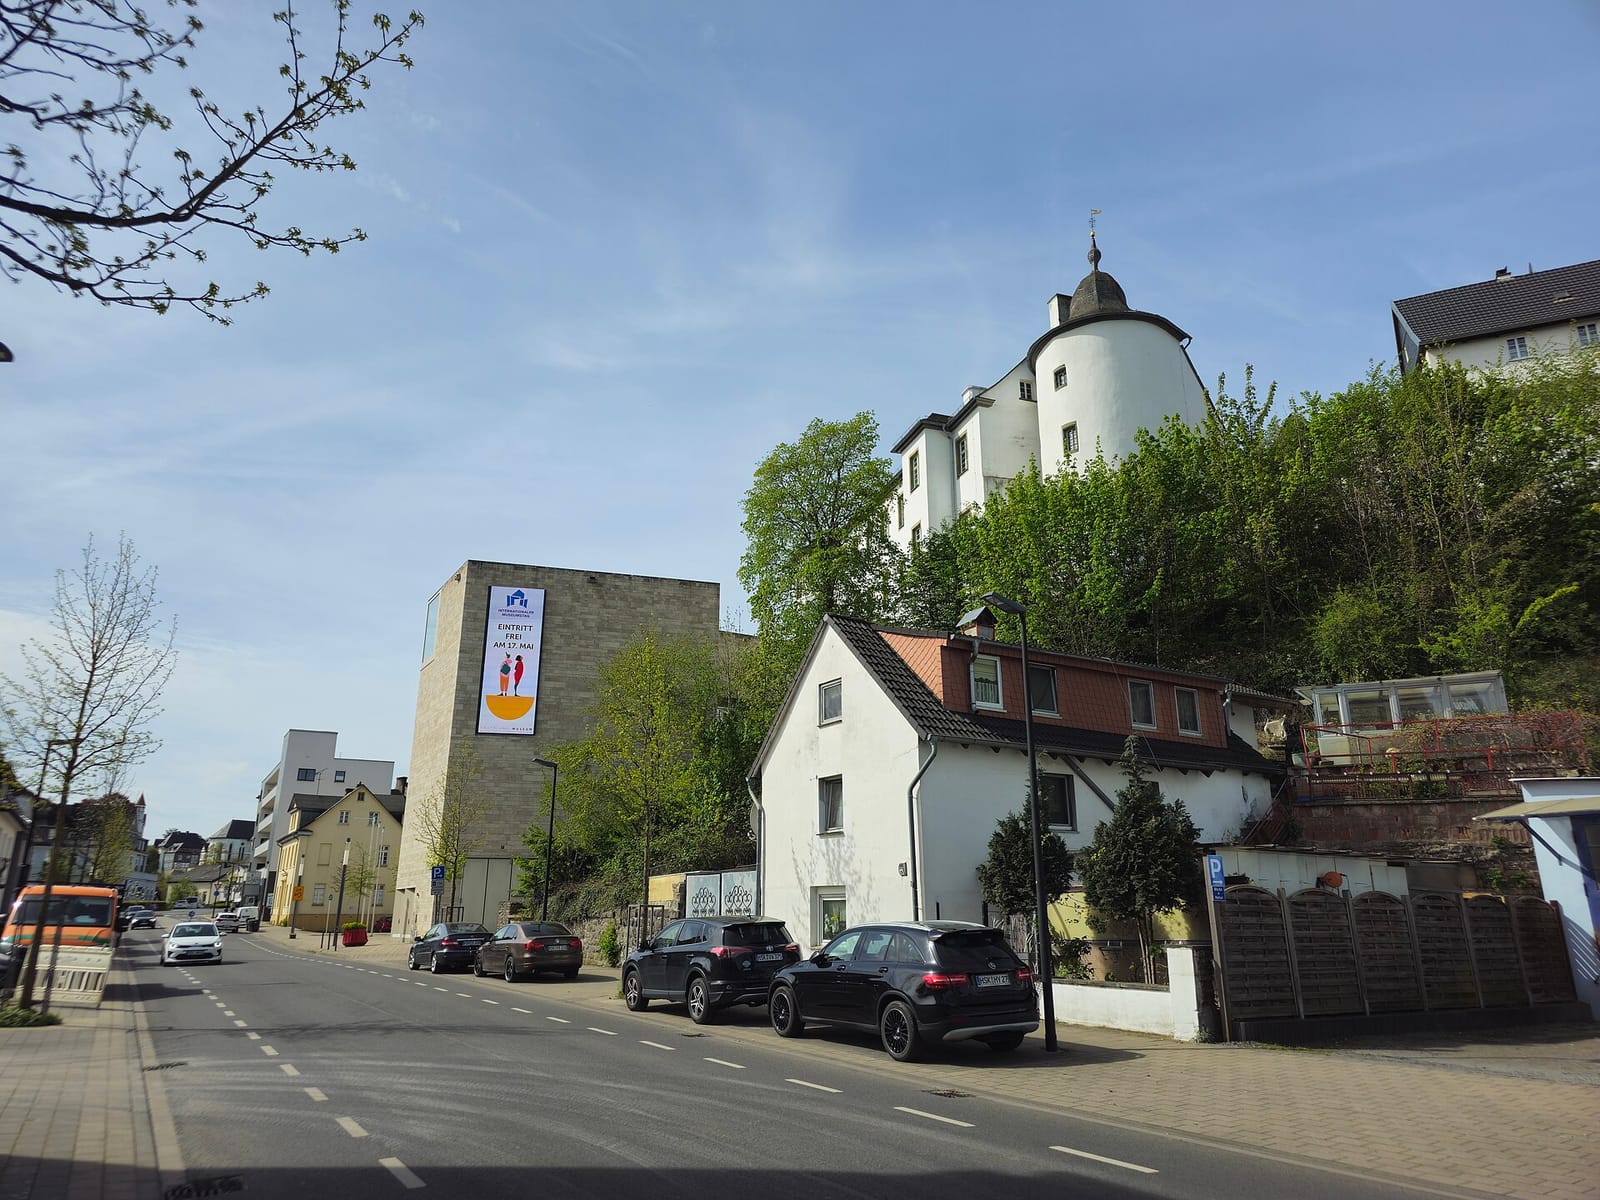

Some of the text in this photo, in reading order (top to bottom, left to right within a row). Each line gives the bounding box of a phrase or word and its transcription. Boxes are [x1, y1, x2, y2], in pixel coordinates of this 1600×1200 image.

[498, 623, 533, 631] EINTRITT
[433, 867, 442, 879] P
[1210, 858, 1221, 879] P
